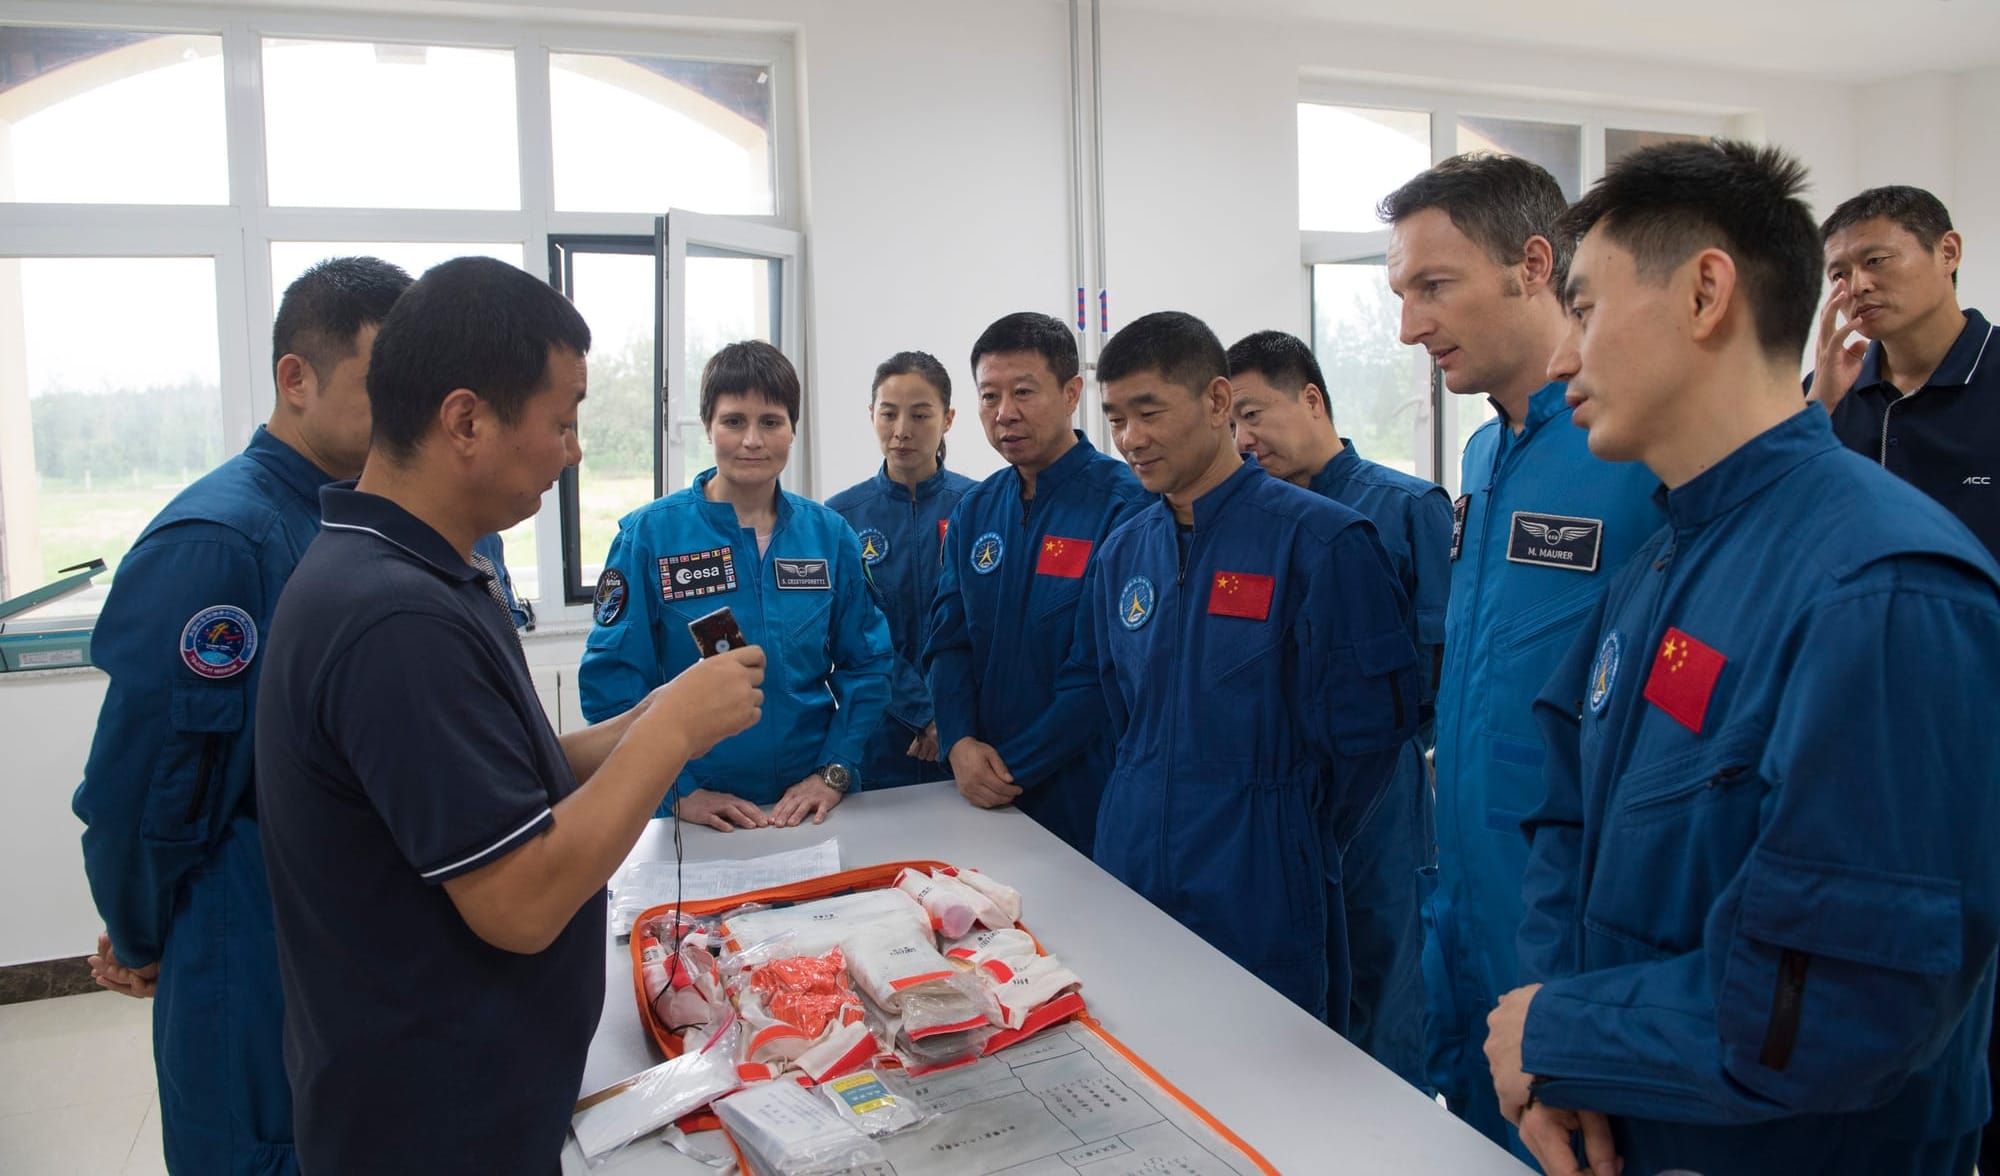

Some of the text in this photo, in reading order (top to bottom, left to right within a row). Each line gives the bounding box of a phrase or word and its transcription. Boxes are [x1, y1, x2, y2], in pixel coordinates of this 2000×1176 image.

[1962, 476, 1991, 485] ACC
[1528, 547, 1574, 561] M. MAURER
[693, 566, 720, 580] esa
